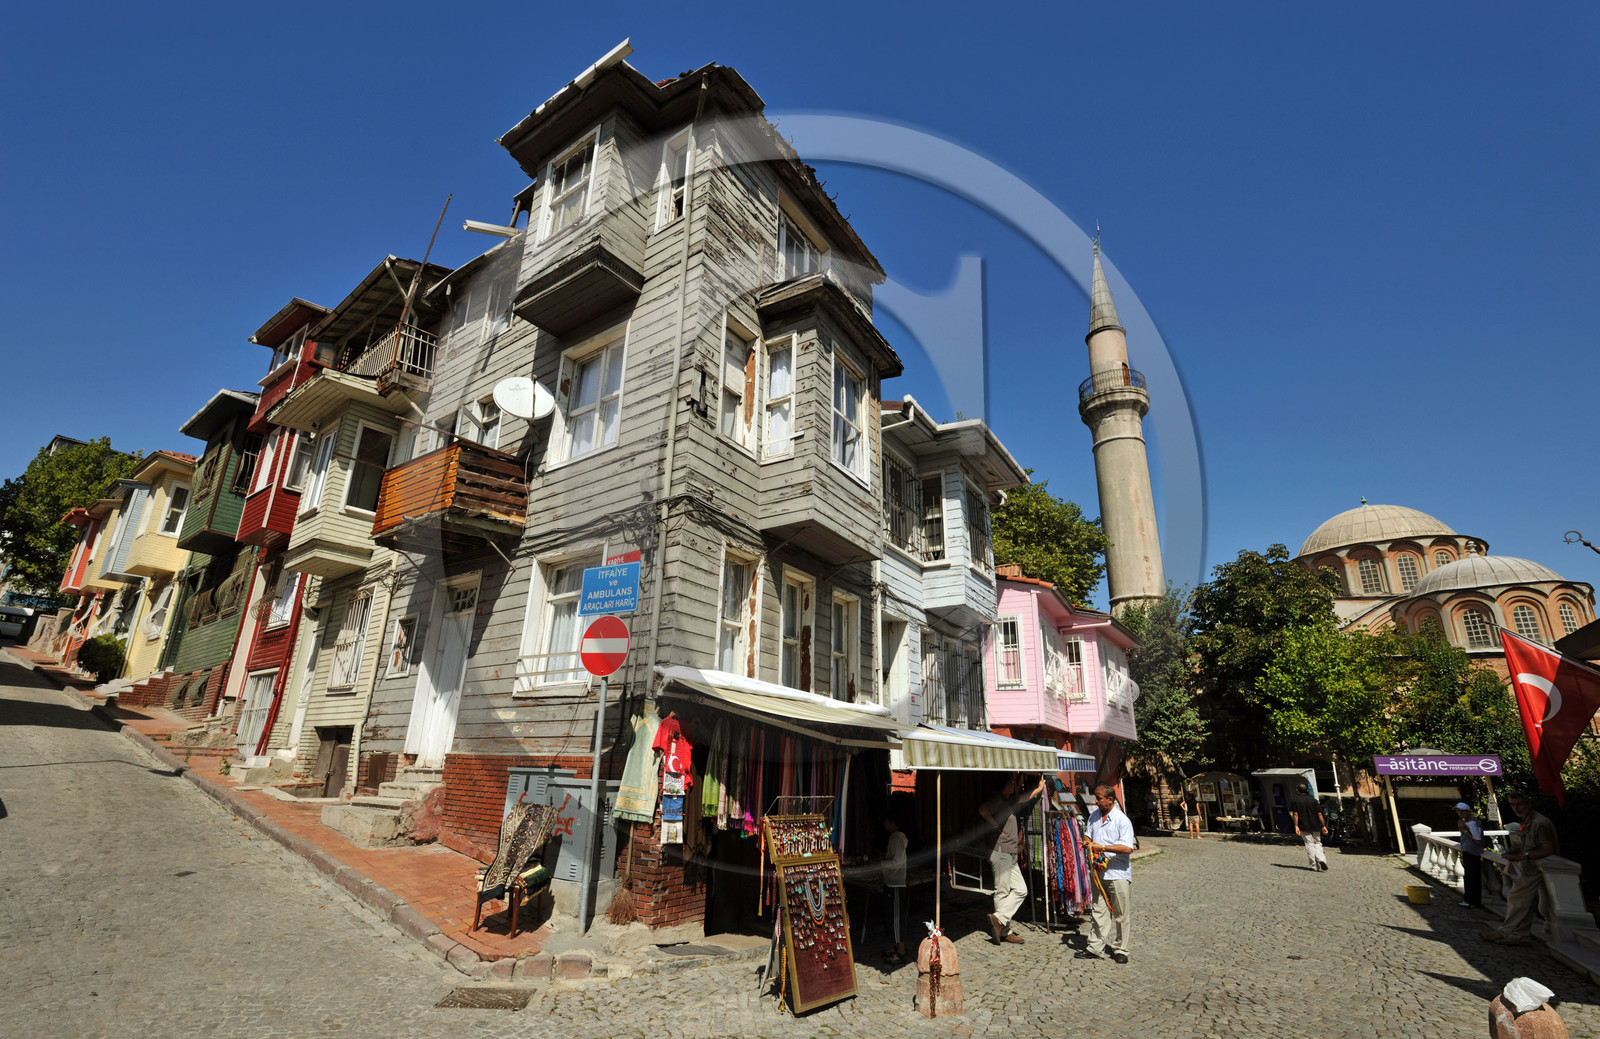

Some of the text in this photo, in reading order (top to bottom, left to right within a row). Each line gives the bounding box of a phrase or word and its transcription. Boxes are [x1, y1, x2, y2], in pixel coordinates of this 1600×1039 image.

[598, 568, 628, 580] İTFAİYE
[587, 586, 633, 600] AMBULANS
[582, 596, 635, 612] ARAÇLARI HARİÇ
